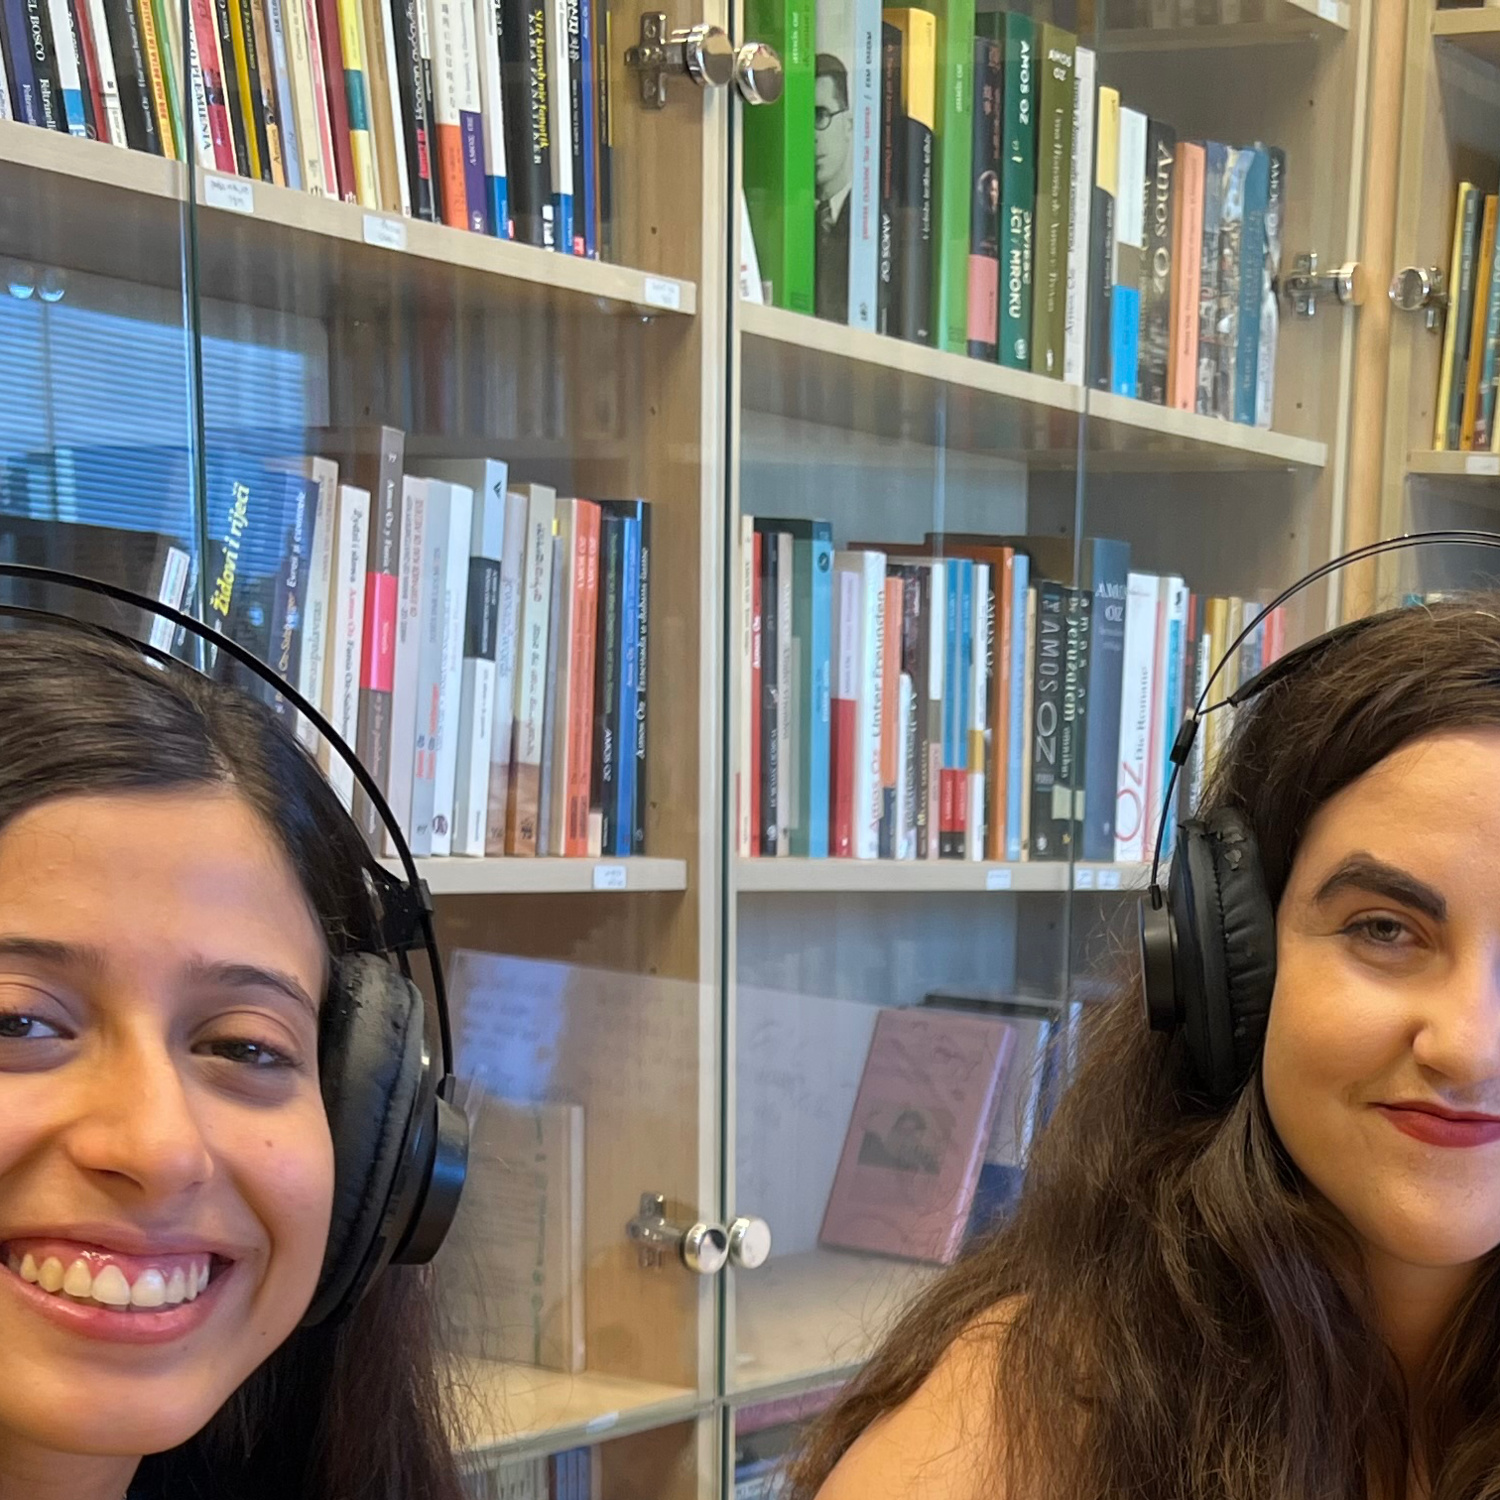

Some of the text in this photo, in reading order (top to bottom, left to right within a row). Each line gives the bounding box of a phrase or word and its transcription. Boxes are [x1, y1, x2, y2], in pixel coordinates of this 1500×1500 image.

[209, 548, 238, 616] Židovi
[1036, 619, 1059, 766] AMOS OZ
